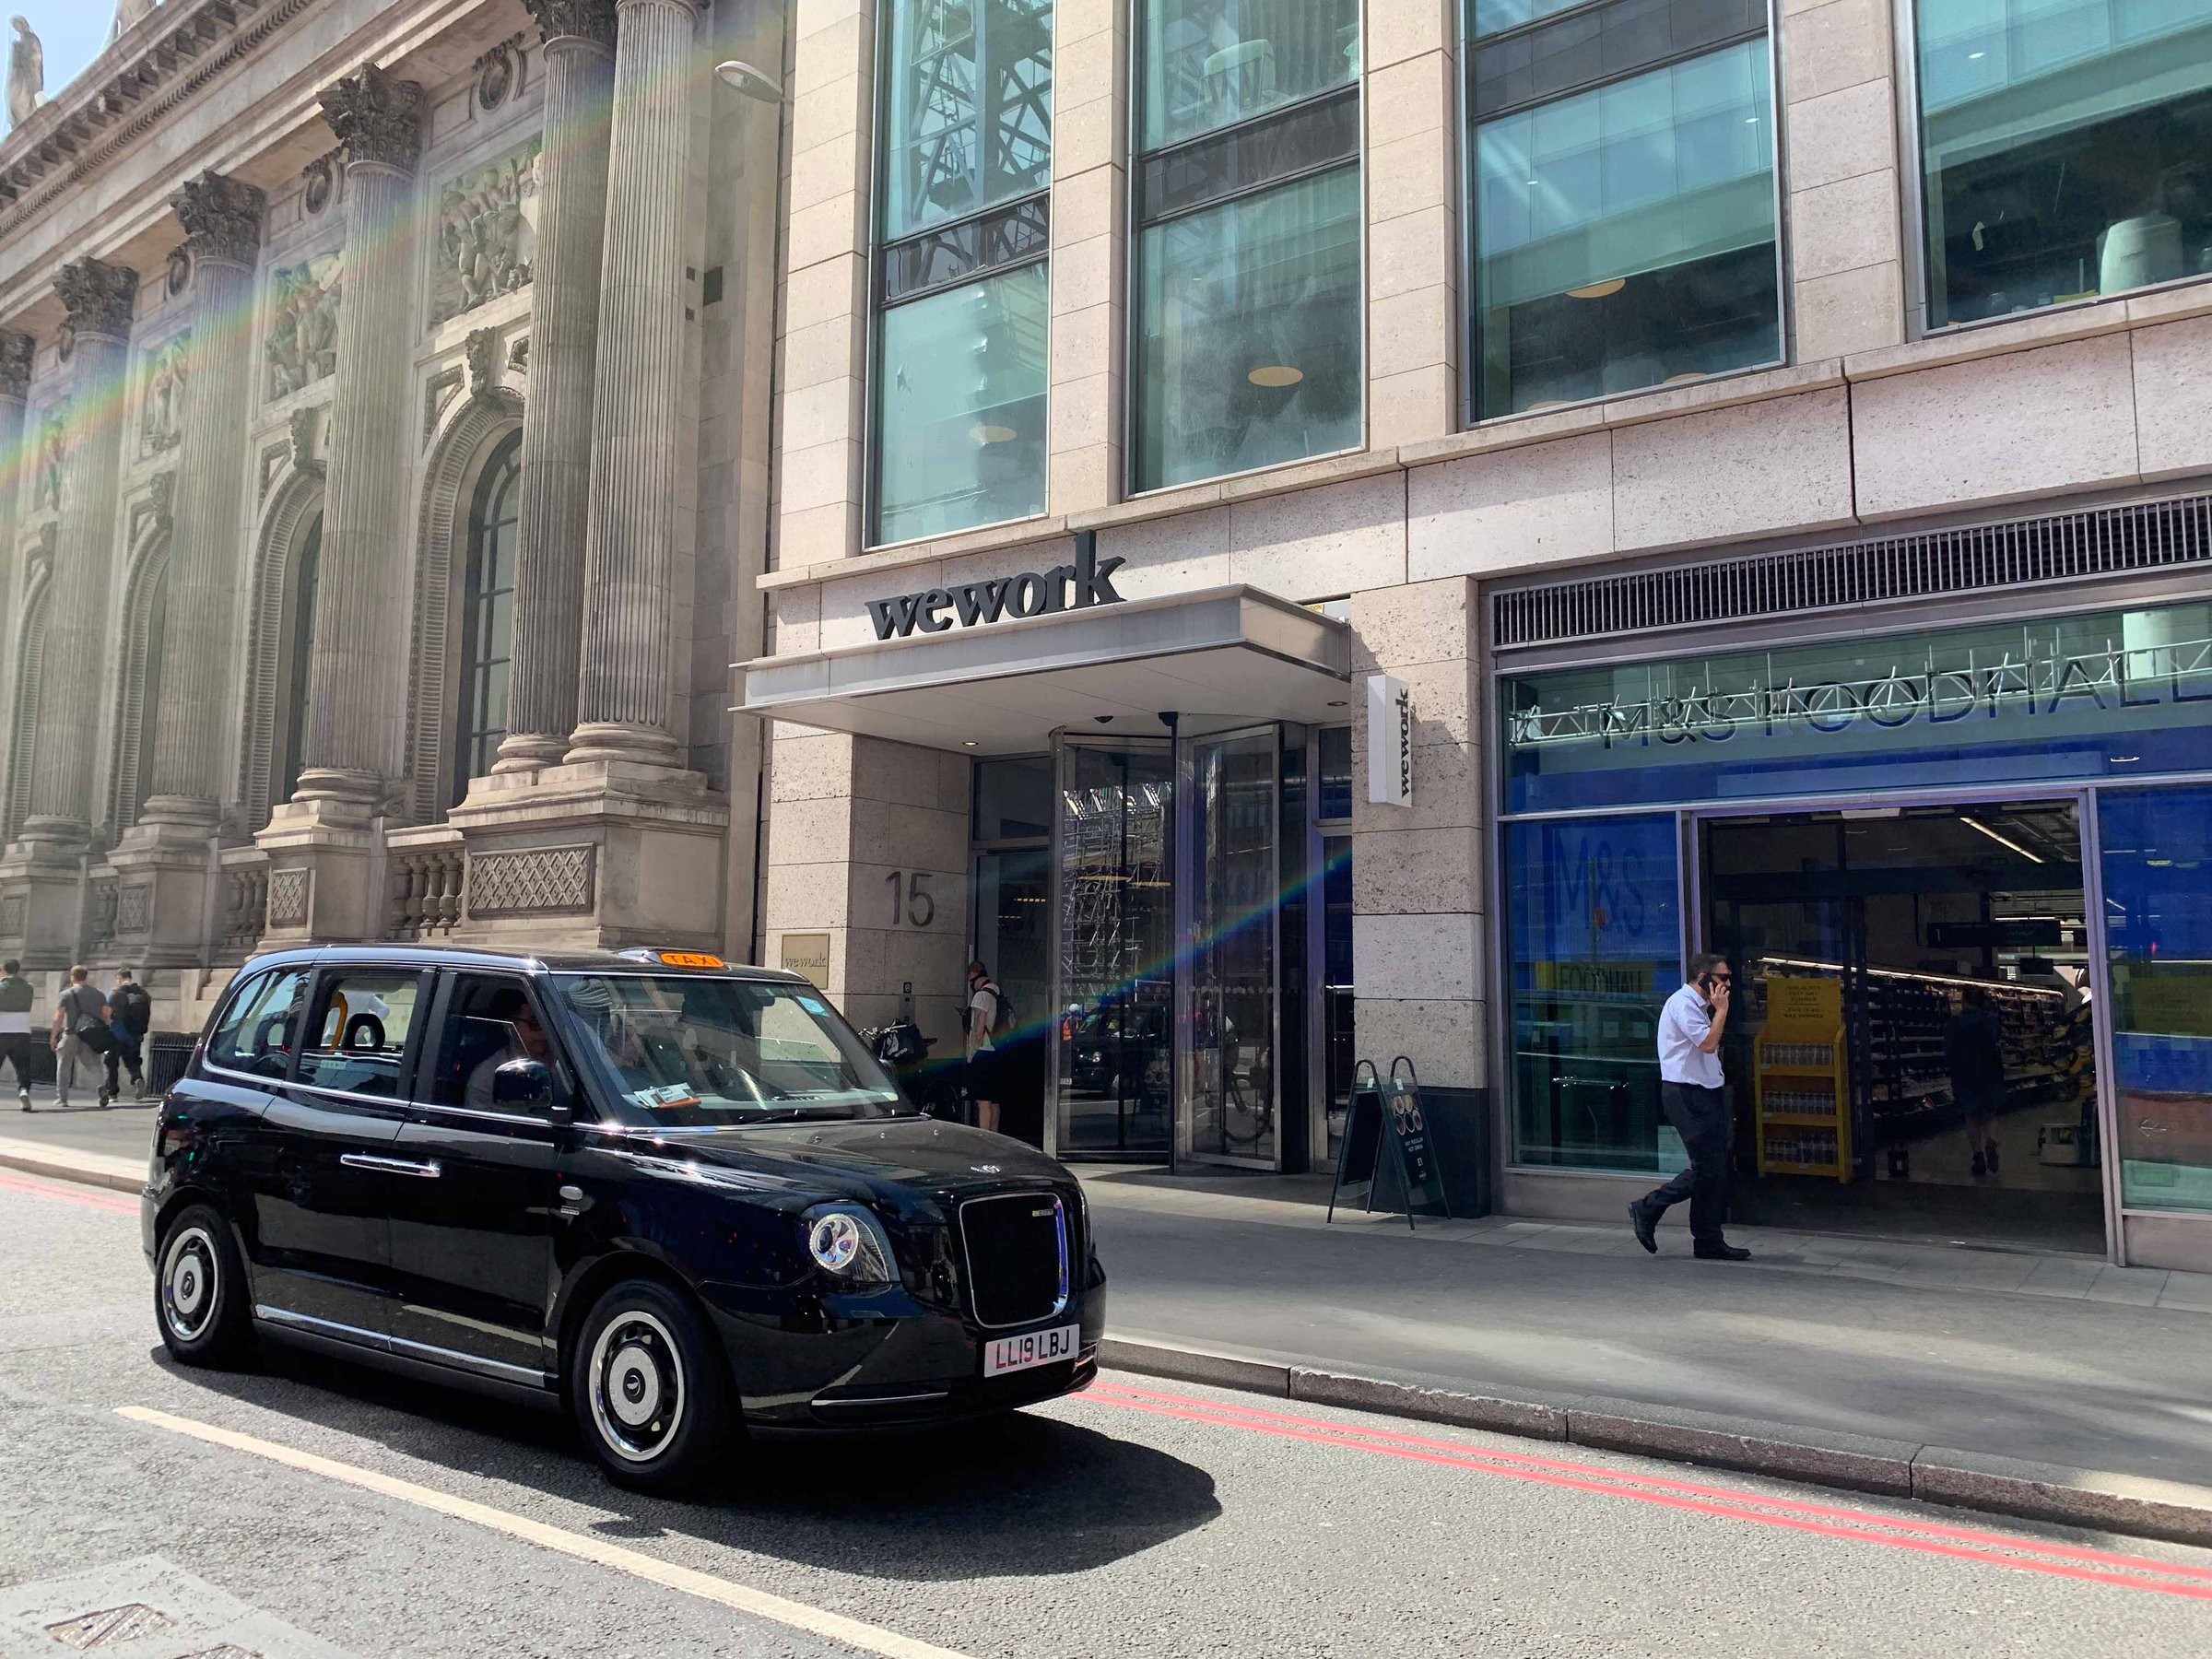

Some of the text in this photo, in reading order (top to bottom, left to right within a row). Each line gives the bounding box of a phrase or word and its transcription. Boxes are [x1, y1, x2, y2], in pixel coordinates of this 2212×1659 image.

[865, 529, 1126, 641] wework
[1605, 646, 2212, 749] M&S FOODHALL
[1395, 688, 1409, 798] wework
[886, 871, 935, 927] 15
[666, 954, 721, 966] TAXI
[785, 952, 827, 968] wework
[996, 1329, 1069, 1370] LL19 LBJ
